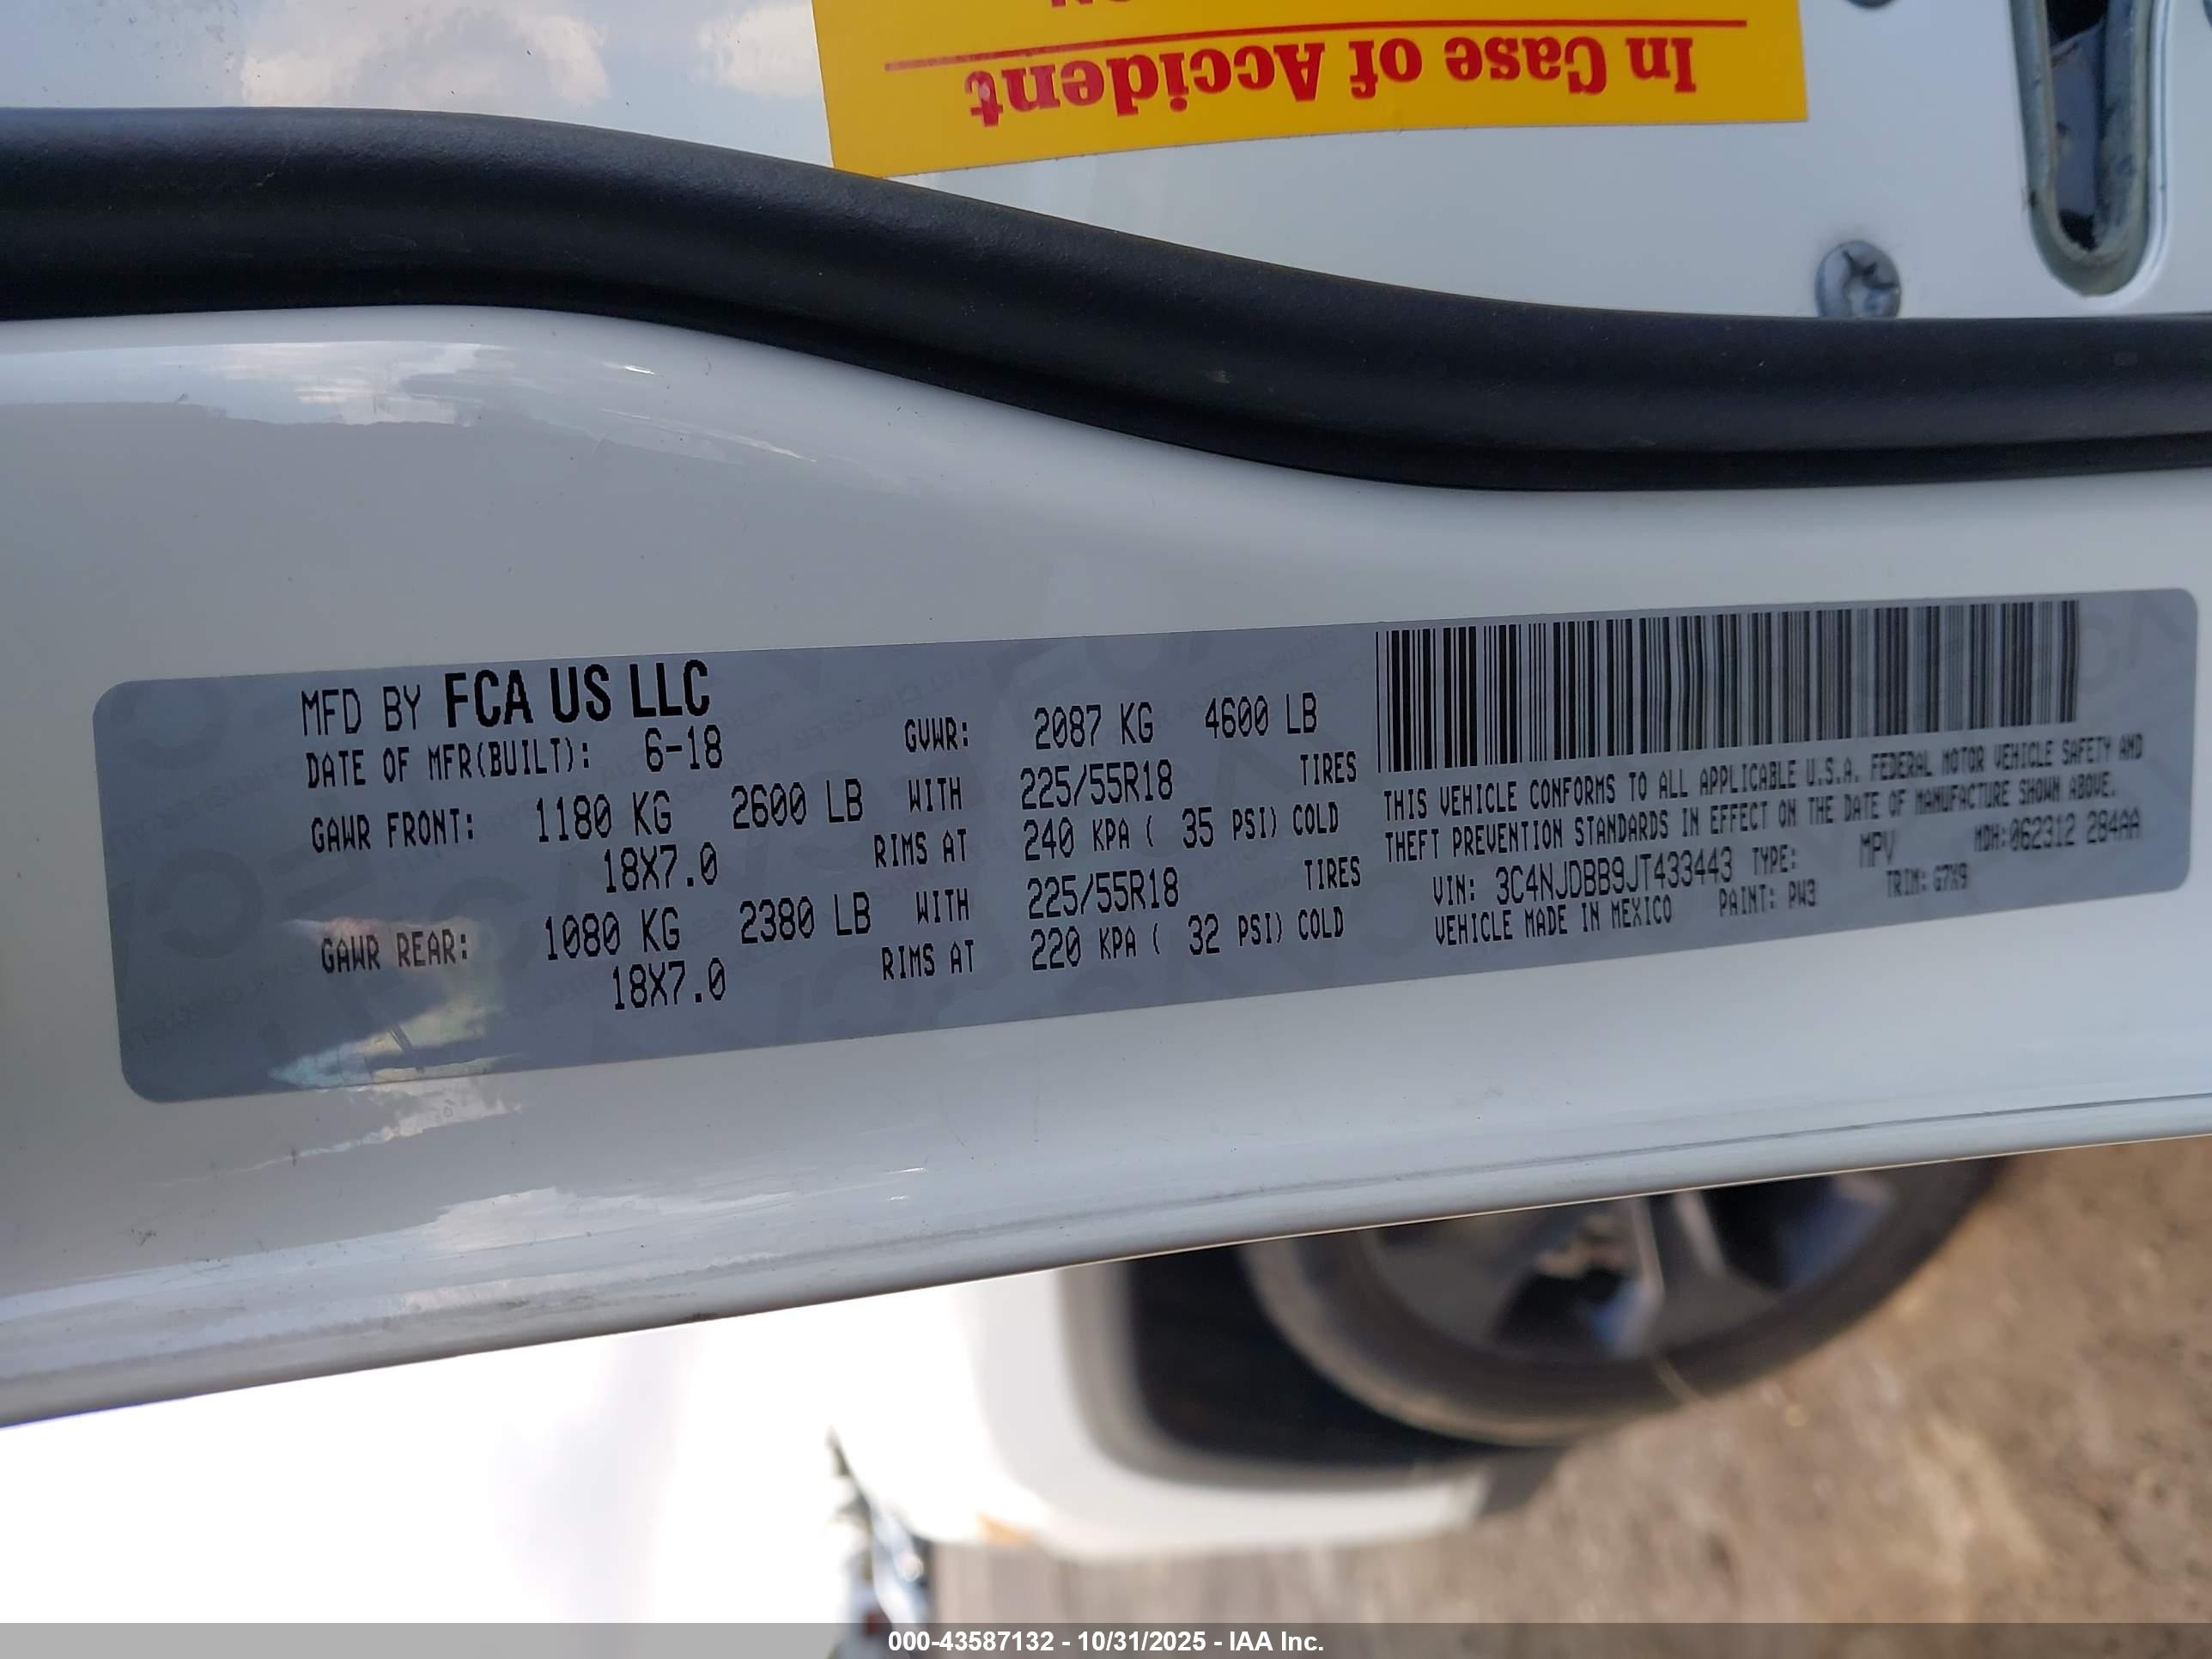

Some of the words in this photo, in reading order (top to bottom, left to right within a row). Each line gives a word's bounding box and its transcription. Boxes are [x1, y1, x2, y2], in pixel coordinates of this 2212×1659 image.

[966, 42, 1323, 128] Accident
[1348, 40, 1424, 99] of
[1445, 37, 1608, 94] Case
[1626, 35, 1697, 92] In
[301, 689, 362, 736] MFD
[383, 685, 420, 732] BY
[445, 670, 533, 727] FCA
[550, 665, 611, 723] US
[629, 659, 709, 717] LLC
[905, 717, 968, 752] GVWR:
[1035, 705, 1101, 750] 2087
[1121, 702, 1153, 744] KG
[1206, 696, 1268, 738] 4600
[1286, 692, 1316, 734] LB
[307, 750, 366, 788] DATE
[383, 747, 409, 783] OF
[428, 738, 589, 780] MFR(BUILT):
[645, 725, 722, 772] 6-18
[1384, 788, 1426, 821] THIS
[1440, 781, 1516, 816] VEHICLE
[1530, 774, 1615, 809] CONFORMS
[1629, 771, 1646, 801] TO
[1659, 769, 1688, 799] ALL
[1700, 760, 1796, 795] APPLICABLE
[1807, 757, 1859, 787] U.S.A.
[1871, 750, 1933, 781] FEDERAL
[1942, 745, 1985, 775] MOTOR
[1995, 740, 2054, 771] VEHICLE
[2062, 737, 2111, 765] SAFETY
[2119, 732, 2143, 760] AND
[312, 815, 370, 853] GAWR
[387, 808, 473, 848] FRONT:
[537, 794, 611, 842] 1180
[633, 790, 672, 836] KG
[732, 782, 806, 829] 2600
[826, 779, 862, 823] LB
[908, 777, 962, 812] WITH
[1021, 759, 1172, 810] 225/55R18
[1300, 751, 1356, 786] TIRES
[1385, 829, 1438, 862] THEFT
[1453, 818, 1562, 857] PREVENTION
[1575, 810, 1668, 847] STANDARDS
[1682, 807, 1698, 837] IN
[1711, 801, 1767, 834] EFFECT
[1778, 799, 1796, 828] ON
[1808, 795, 1834, 824] THE
[1844, 792, 1880, 822] DATE
[1889, 788, 1908, 817] OF
[1916, 780, 2010, 815] MANUFACTURE
[2019, 776, 2061, 805] SHOWN
[2069, 771, 2115, 800] ABOVE.
[605, 842, 717, 893] 18X7.0
[874, 832, 927, 867] RIMS
[943, 829, 966, 862] AT
[1024, 817, 1073, 860] 240
[1093, 817, 1129, 851] KPA
[1146, 815, 1153, 847] (
[1182, 807, 1213, 848] 35
[1233, 806, 1276, 841] PSI)
[1293, 802, 1338, 836] COLD
[1433, 874, 1474, 906] VIN:
[1496, 846, 1733, 905] 3C4NJDBB9JT433443
[1752, 844, 1795, 875] TYPE:
[1860, 830, 1894, 866] MPV
[2087, 807, 2140, 844] 284AA
[321, 935, 380, 974] GAWR
[397, 929, 467, 968] REAR:
[546, 912, 620, 960] 1080
[641, 907, 679, 952] KG
[740, 896, 814, 944] 2380
[835, 892, 871, 935] LB
[916, 888, 969, 924] WITH
[1028, 867, 1178, 919] 225/55R18
[1304, 856, 1360, 890] TIRES
[1436, 909, 1512, 945] VEHICLE
[1525, 904, 1567, 938] MADE
[1582, 902, 1600, 932] IN
[1611, 895, 1672, 928] MEXICO
[1719, 884, 1774, 916] PAINT:
[1789, 878, 1816, 908] PW3
[1886, 868, 1927, 896] TRIM:
[613, 957, 726, 1010] 18X7.0
[882, 944, 934, 980] RIMS
[951, 939, 974, 974] AT
[1031, 926, 1081, 970] 220
[1099, 926, 1136, 959] KPA
[1153, 923, 1159, 954] (
[1188, 914, 1219, 955] 32
[1238, 913, 1282, 946] PSI)
[1298, 907, 1343, 940] COLD
